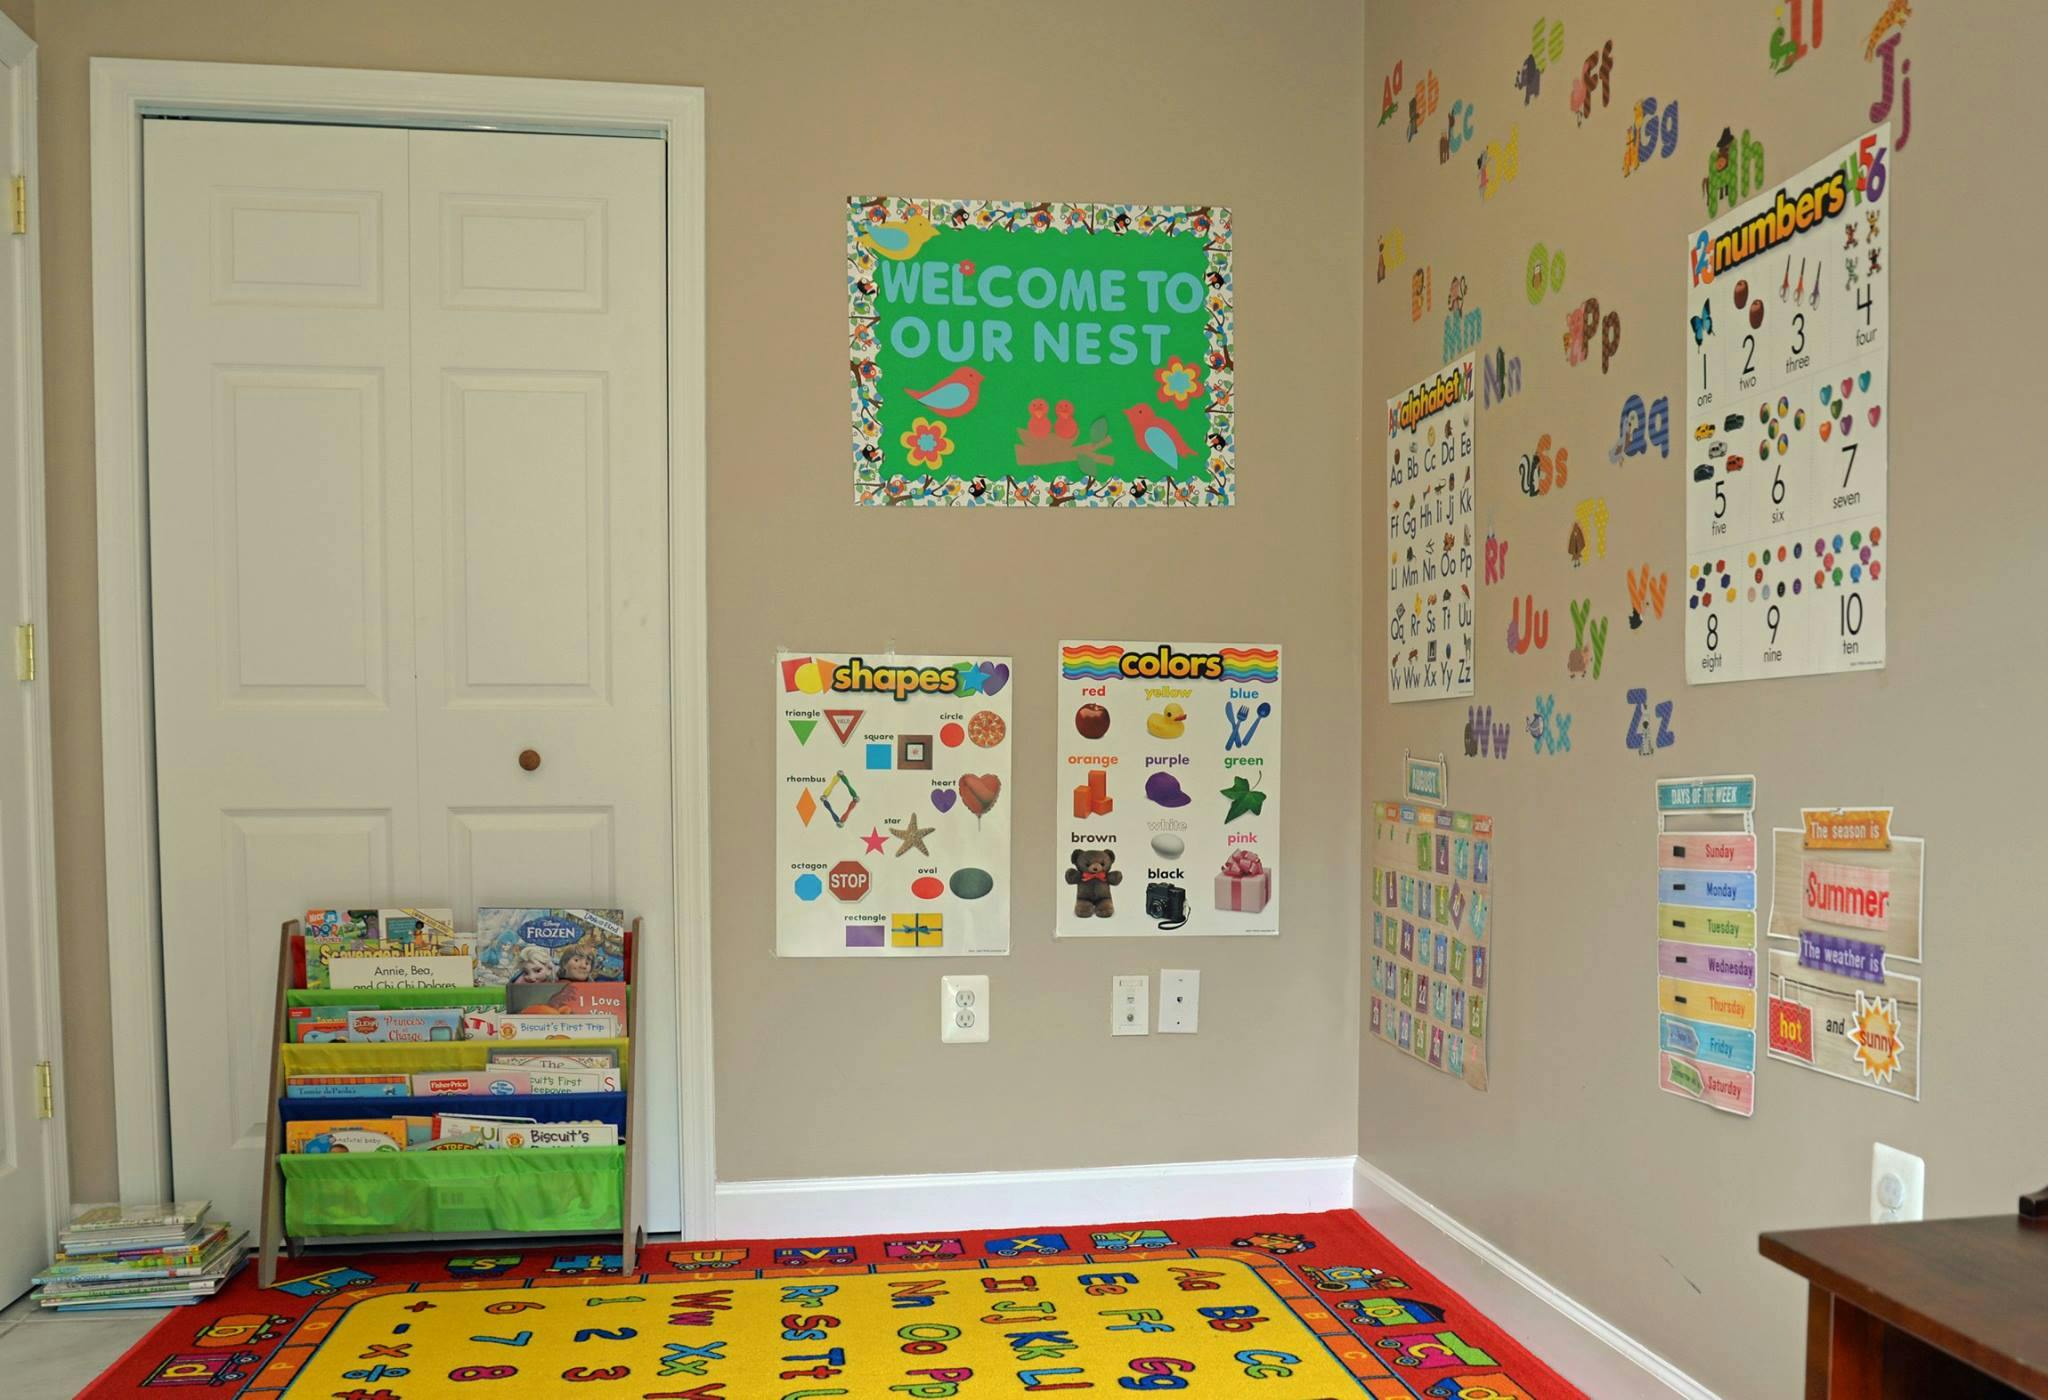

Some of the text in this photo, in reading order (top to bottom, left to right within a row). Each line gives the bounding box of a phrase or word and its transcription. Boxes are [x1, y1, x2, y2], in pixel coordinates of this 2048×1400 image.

[1869, 32, 1910, 152] Jj
[1449, 98, 1473, 153] Cc
[1634, 97, 1678, 162] Gg
[1708, 129, 1764, 219] Hh
[1714, 169, 1847, 277] numbers
[1526, 242, 1566, 306] Oo
[881, 260, 1204, 313] WELCOME TO
[1856, 283, 1872, 325] 4
[890, 316, 1171, 365] OUR NEST
[1443, 308, 1482, 364] Mm
[1581, 298, 1620, 374] Pp
[1792, 313, 1804, 355] 3
[1856, 327, 1877, 347] four
[1742, 335, 1755, 374] 2
[1786, 355, 1810, 374] three
[1484, 347, 1521, 410] Nn
[1739, 376, 1756, 391] two
[1400, 368, 1459, 434] alphabet
[1697, 392, 1712, 407] one
[1390, 432, 1471, 488] Aa Bb Cc Dd Ee
[1536, 434, 1568, 496] Ss
[1842, 443, 1858, 488] 7
[1772, 464, 1785, 504] 6
[1714, 481, 1726, 518] 5
[1833, 491, 1860, 509] seven
[1391, 515, 1399, 539] Ff
[1403, 511, 1416, 539] Gg
[1421, 504, 1432, 529] Hh
[1446, 495, 1454, 525] Jj
[1460, 488, 1471, 514] Kk
[1772, 508, 1784, 523] six
[1712, 522, 1726, 535] five
[1402, 565, 1418, 588] Mm
[1423, 558, 1436, 582] Nn
[1441, 552, 1456, 577] Oo
[1461, 548, 1472, 578] Pp
[1485, 538, 1508, 585] Rr
[1627, 563, 1668, 620] Vv
[1391, 602, 1471, 645] Qq Rr Ss Tt Uu
[1512, 594, 1548, 655] Uu
[1767, 605, 1780, 644] 9
[1841, 593, 1863, 636] 10
[1570, 598, 1608, 680] Yy
[1707, 613, 1718, 650] 8
[1764, 648, 1782, 662] nine
[1843, 640, 1858, 655] ten
[1120, 645, 1224, 679] colors
[1702, 653, 1722, 672] eight
[833, 657, 959, 701] shapes
[1391, 659, 1471, 692] Vv Ww Xx Yy Zz
[1082, 686, 1106, 697] red
[1144, 687, 1192, 700] yellow
[1230, 688, 1259, 699] blue
[785, 709, 821, 718] triangle
[940, 713, 963, 721] circle
[1626, 688, 1674, 750] Zz
[1468, 705, 1510, 760] Ww
[1534, 694, 1571, 755] Xx
[864, 733, 894, 743] square
[1068, 754, 1118, 768] orange
[1145, 754, 1190, 767] purple
[1224, 756, 1264, 768] green
[787, 775, 826, 784] rhombus
[1672, 789, 1690, 804] DAYS
[1692, 788, 1701, 803] OF
[1716, 786, 1737, 803] WEEK
[884, 817, 901, 825] star
[1147, 820, 1188, 832] white
[1811, 821, 1880, 839] The season is
[1071, 832, 1117, 844] brown
[1228, 833, 1258, 846] pink
[1705, 844, 1734, 861] Sunday
[791, 862, 828, 871] octagon
[1148, 868, 1184, 879] black
[831, 873, 867, 888] STOP
[1706, 882, 1737, 900] Monday
[1807, 871, 1889, 918] Summer
[844, 914, 886, 922] rectangle
[312, 924, 344, 936] DORA
[527, 927, 575, 938] FROZEN
[1707, 919, 1739, 938] Tuesday
[1803, 940, 1879, 970] The weather is
[374, 966, 433, 976] Annie, Bea,
[1709, 958, 1753, 978] Wednesday
[580, 997, 620, 1007] I Love
[1709, 996, 1745, 1018] Thursday
[384, 1015, 425, 1026] Princess
[521, 1023, 605, 1032] Biscuit's First Trip
[388, 1029, 422, 1041] Charge
[1779, 1013, 1896, 1058] hot and sunny
[1711, 1037, 1733, 1058] Friday
[541, 1060, 565, 1069] The
[558, 1078, 582, 1086] First
[604, 1077, 615, 1093] S
[1708, 1076, 1742, 1100] Saturday
[531, 1130, 589, 1142] Biscuit's
